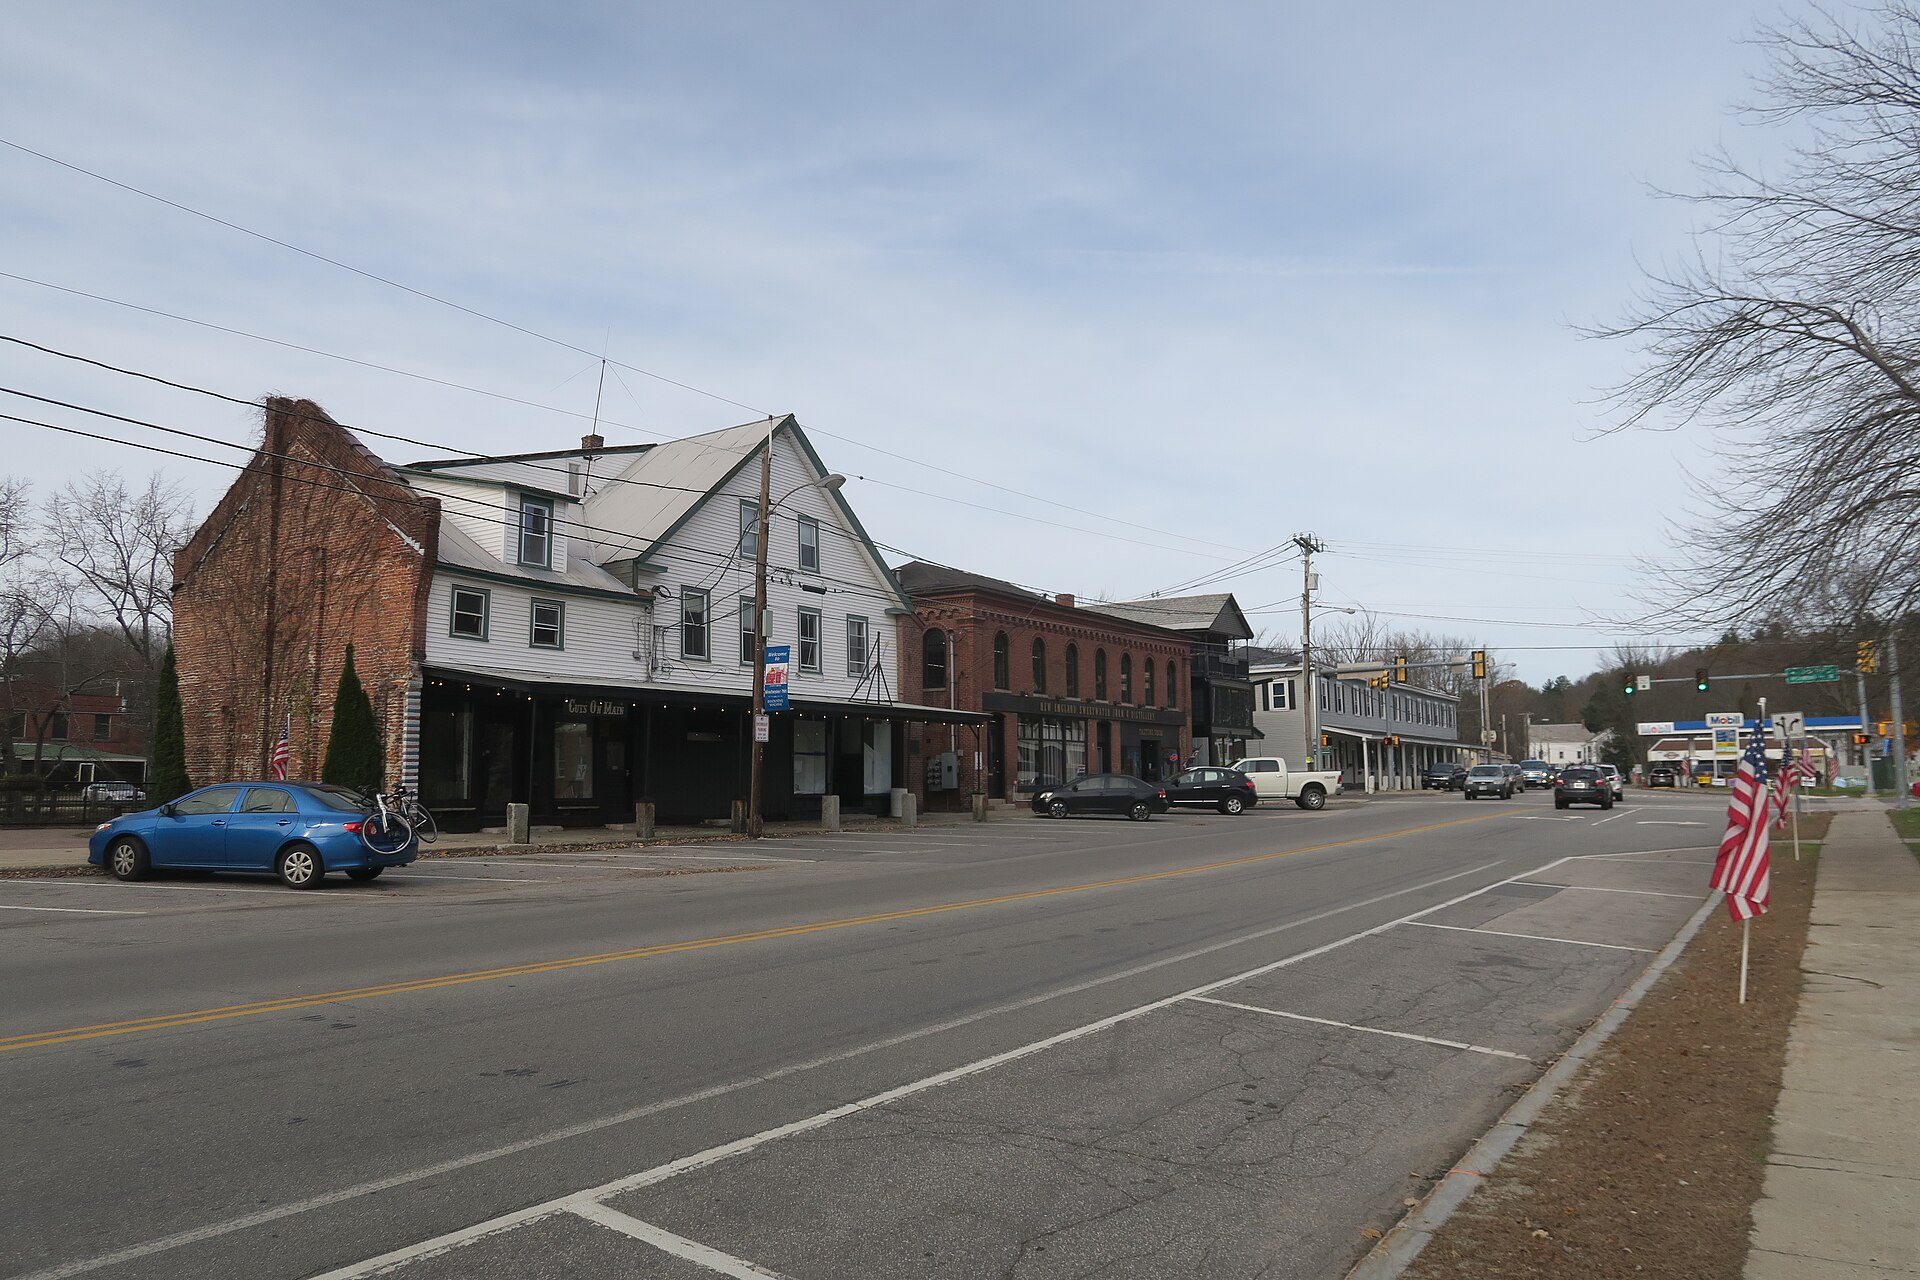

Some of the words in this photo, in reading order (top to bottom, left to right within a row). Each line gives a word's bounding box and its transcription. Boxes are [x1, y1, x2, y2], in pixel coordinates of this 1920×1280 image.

[1040, 702, 1052, 712] NEW
[1054, 703, 1076, 714] ENGLAND
[1711, 715, 1740, 725] Mobil
